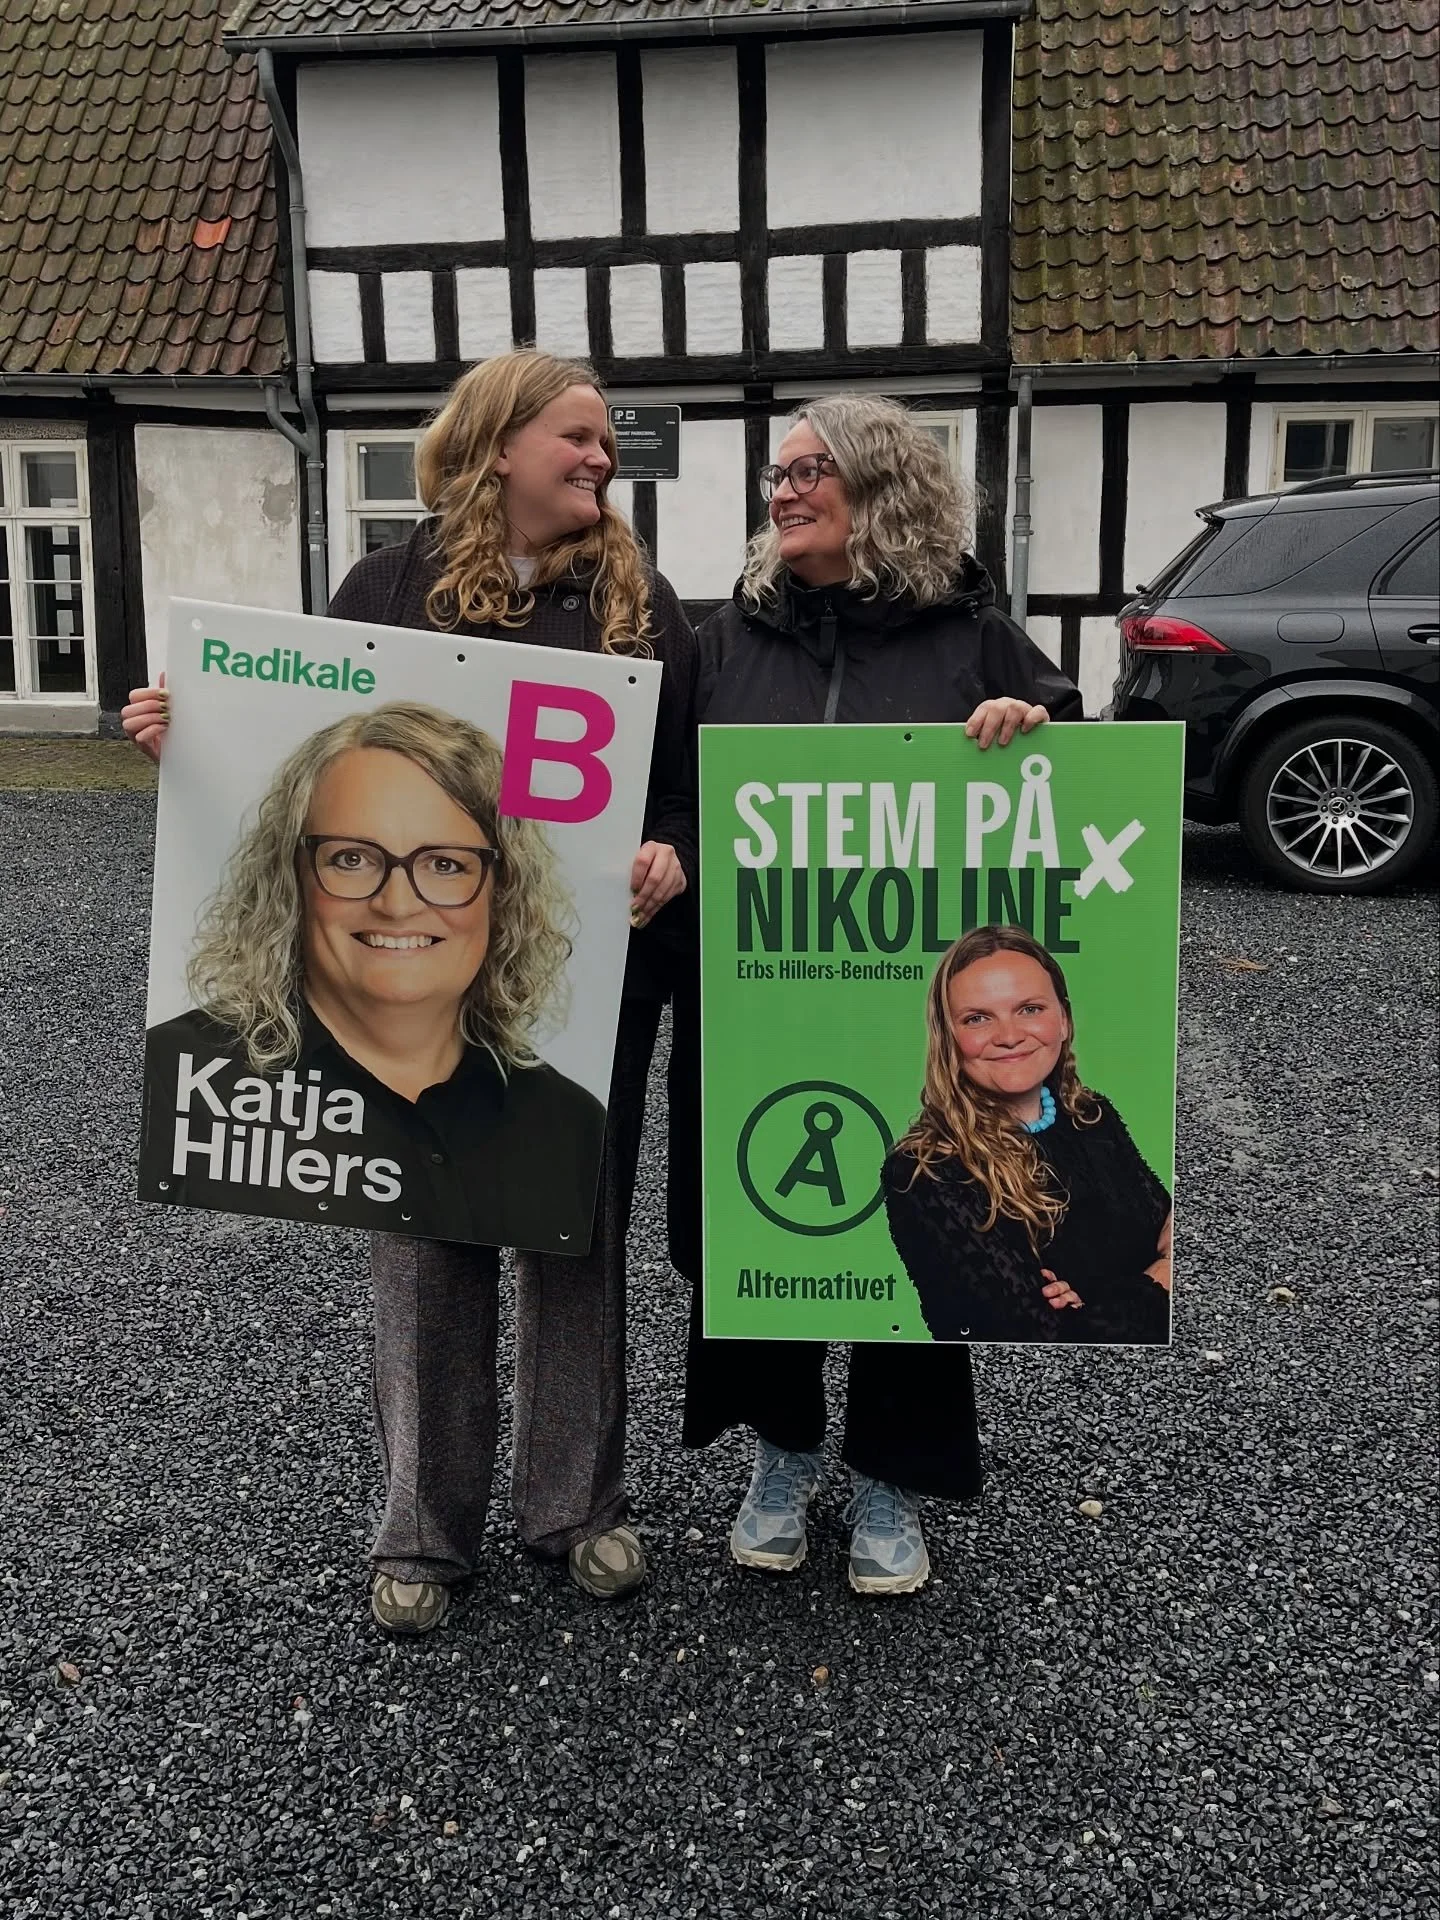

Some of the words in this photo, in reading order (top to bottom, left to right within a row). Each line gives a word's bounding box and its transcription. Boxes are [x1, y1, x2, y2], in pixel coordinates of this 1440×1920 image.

[202, 638, 376, 695] Radikale
[499, 680, 616, 824] B
[734, 782, 936, 869] STEM
[965, 754, 1061, 869] PÅ
[736, 867, 1081, 954] NIKOLINE
[737, 959, 774, 979] Erbs
[779, 959, 924, 981] Hillers-Bendtsen
[175, 1052, 366, 1141] Katja
[172, 1117, 403, 1203] Hillers
[774, 1101, 846, 1207] Å
[737, 1268, 897, 1301] Alternativet
